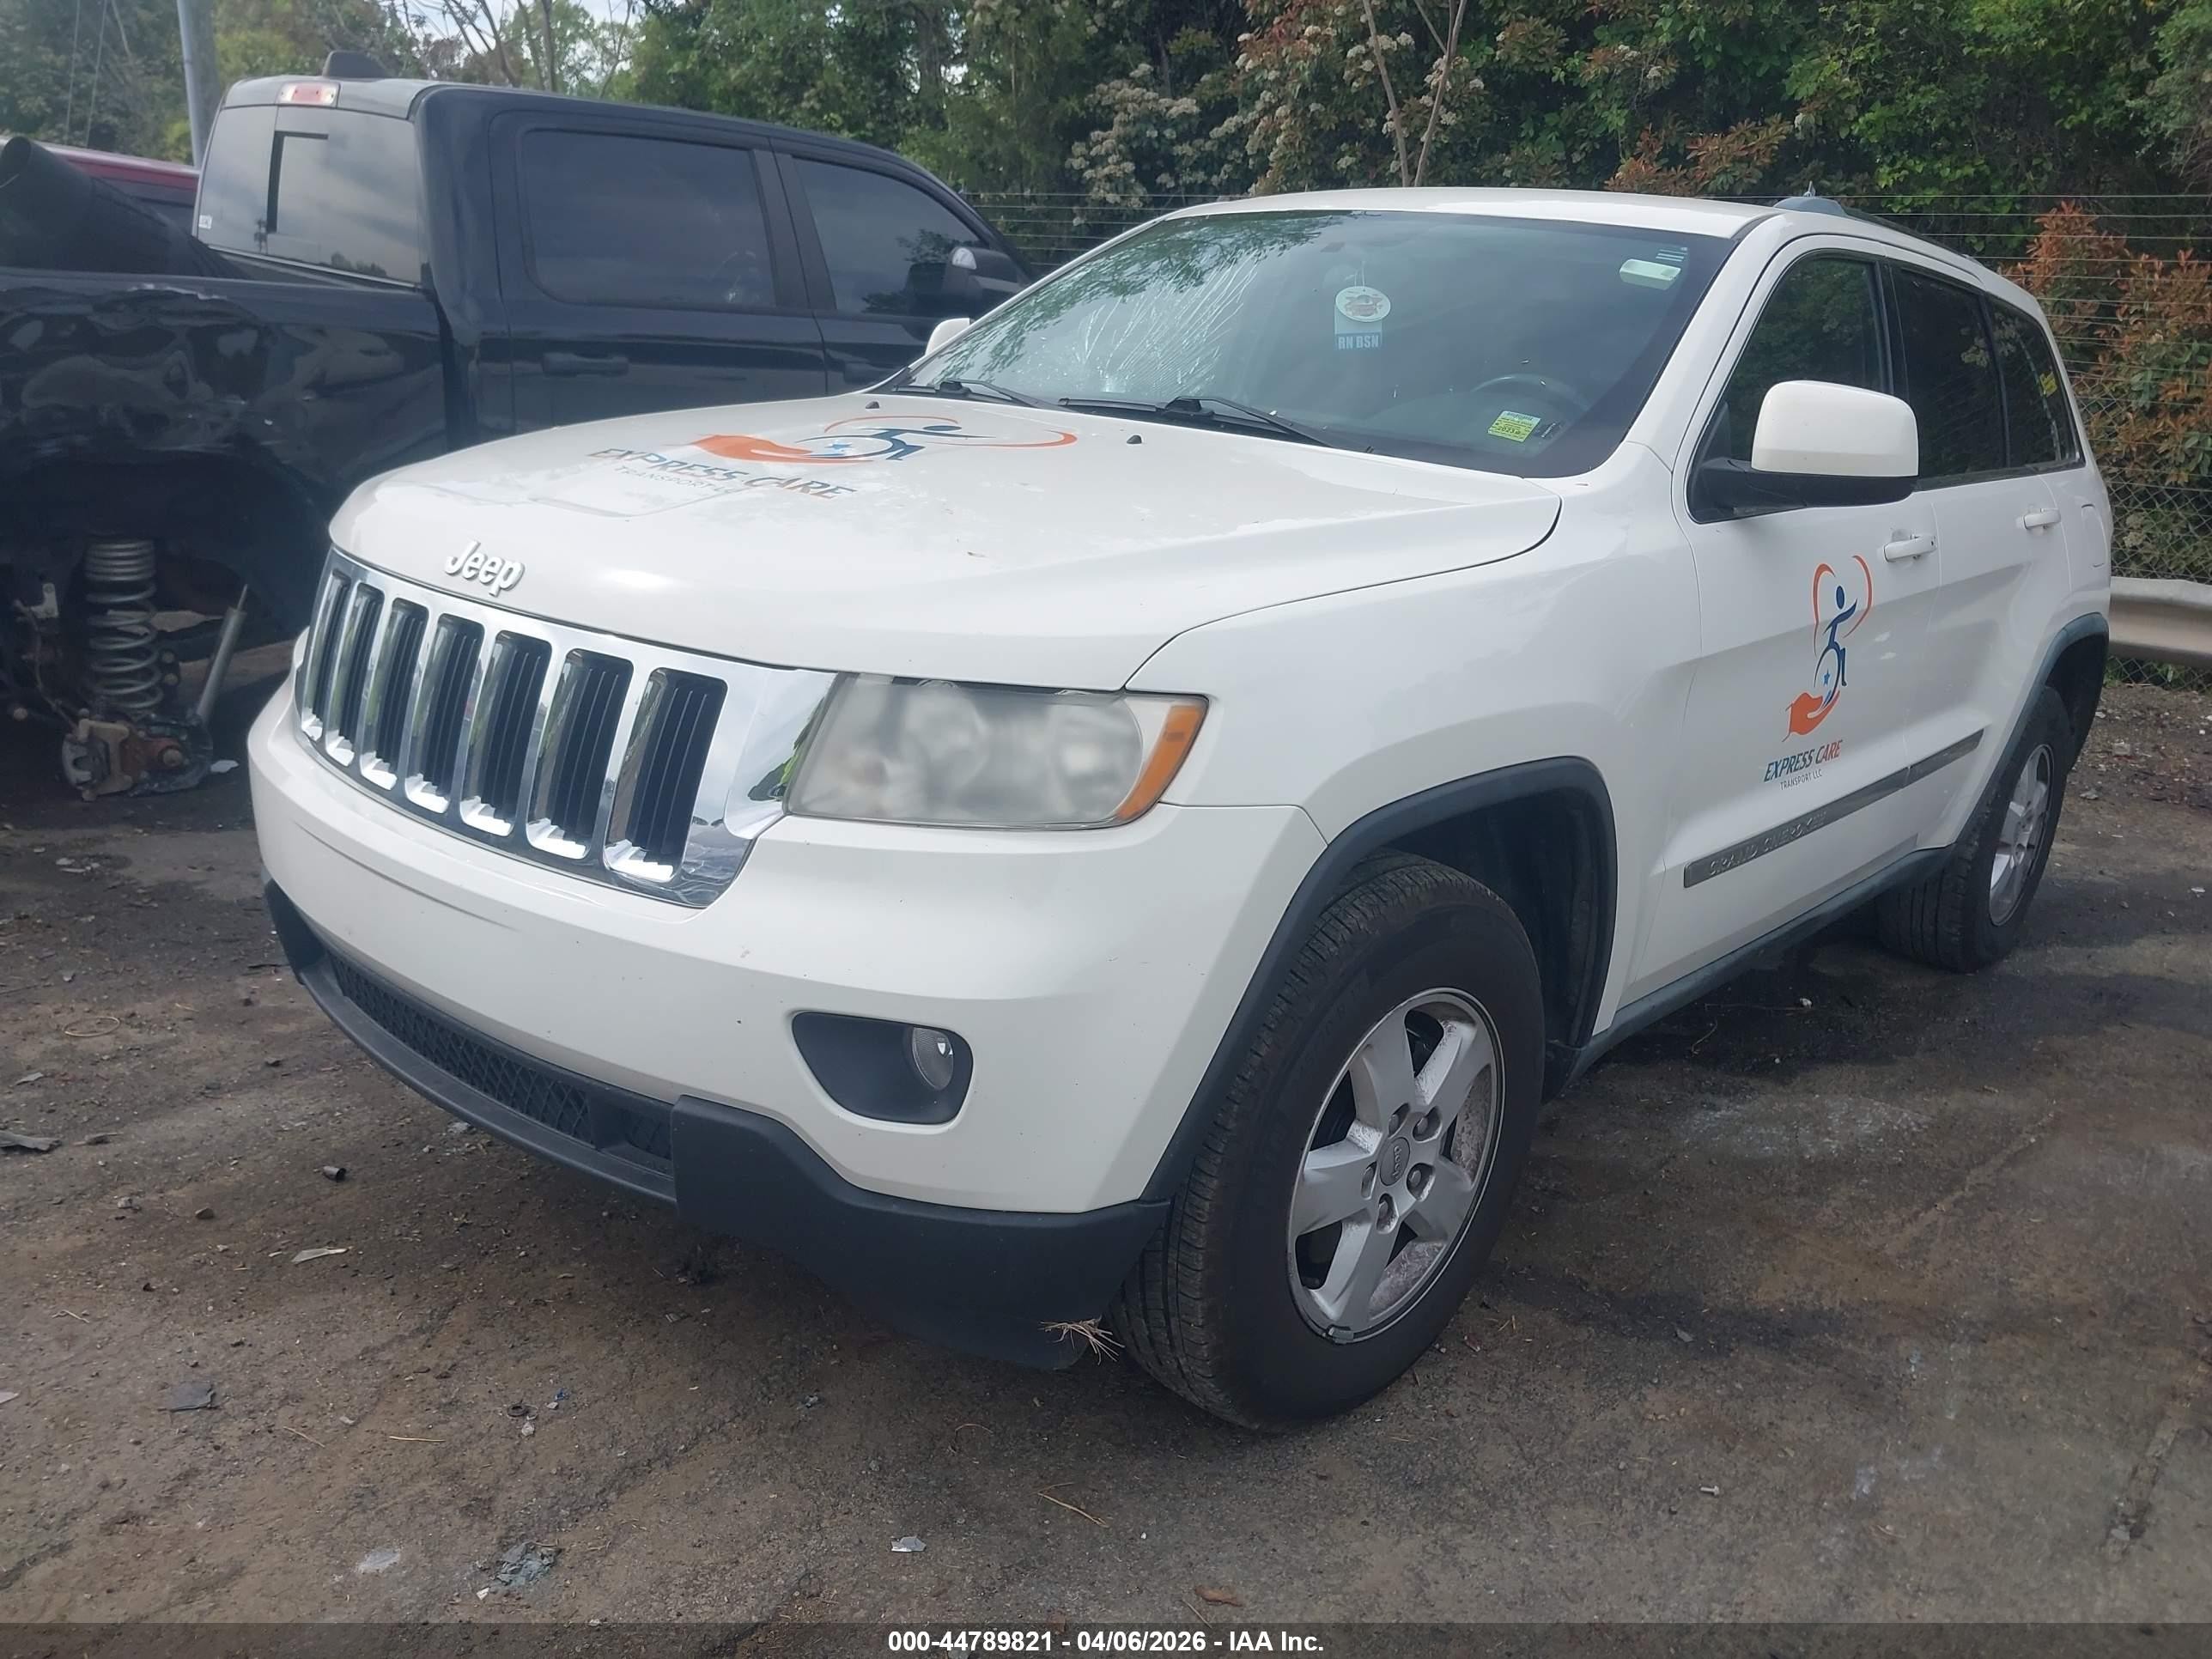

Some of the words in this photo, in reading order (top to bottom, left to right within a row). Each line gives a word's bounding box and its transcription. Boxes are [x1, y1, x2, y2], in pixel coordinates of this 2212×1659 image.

[586, 448, 750, 481] EXPRESS
[742, 477, 858, 500] CARE
[615, 465, 716, 489] TRANSPORT
[444, 540, 526, 598] Jeep
[1763, 749, 1815, 783] EXPRESS
[1815, 739, 1844, 764] CARE
[1780, 774, 1812, 791] TRANSPORT
[1813, 769, 1822, 780] LLC
